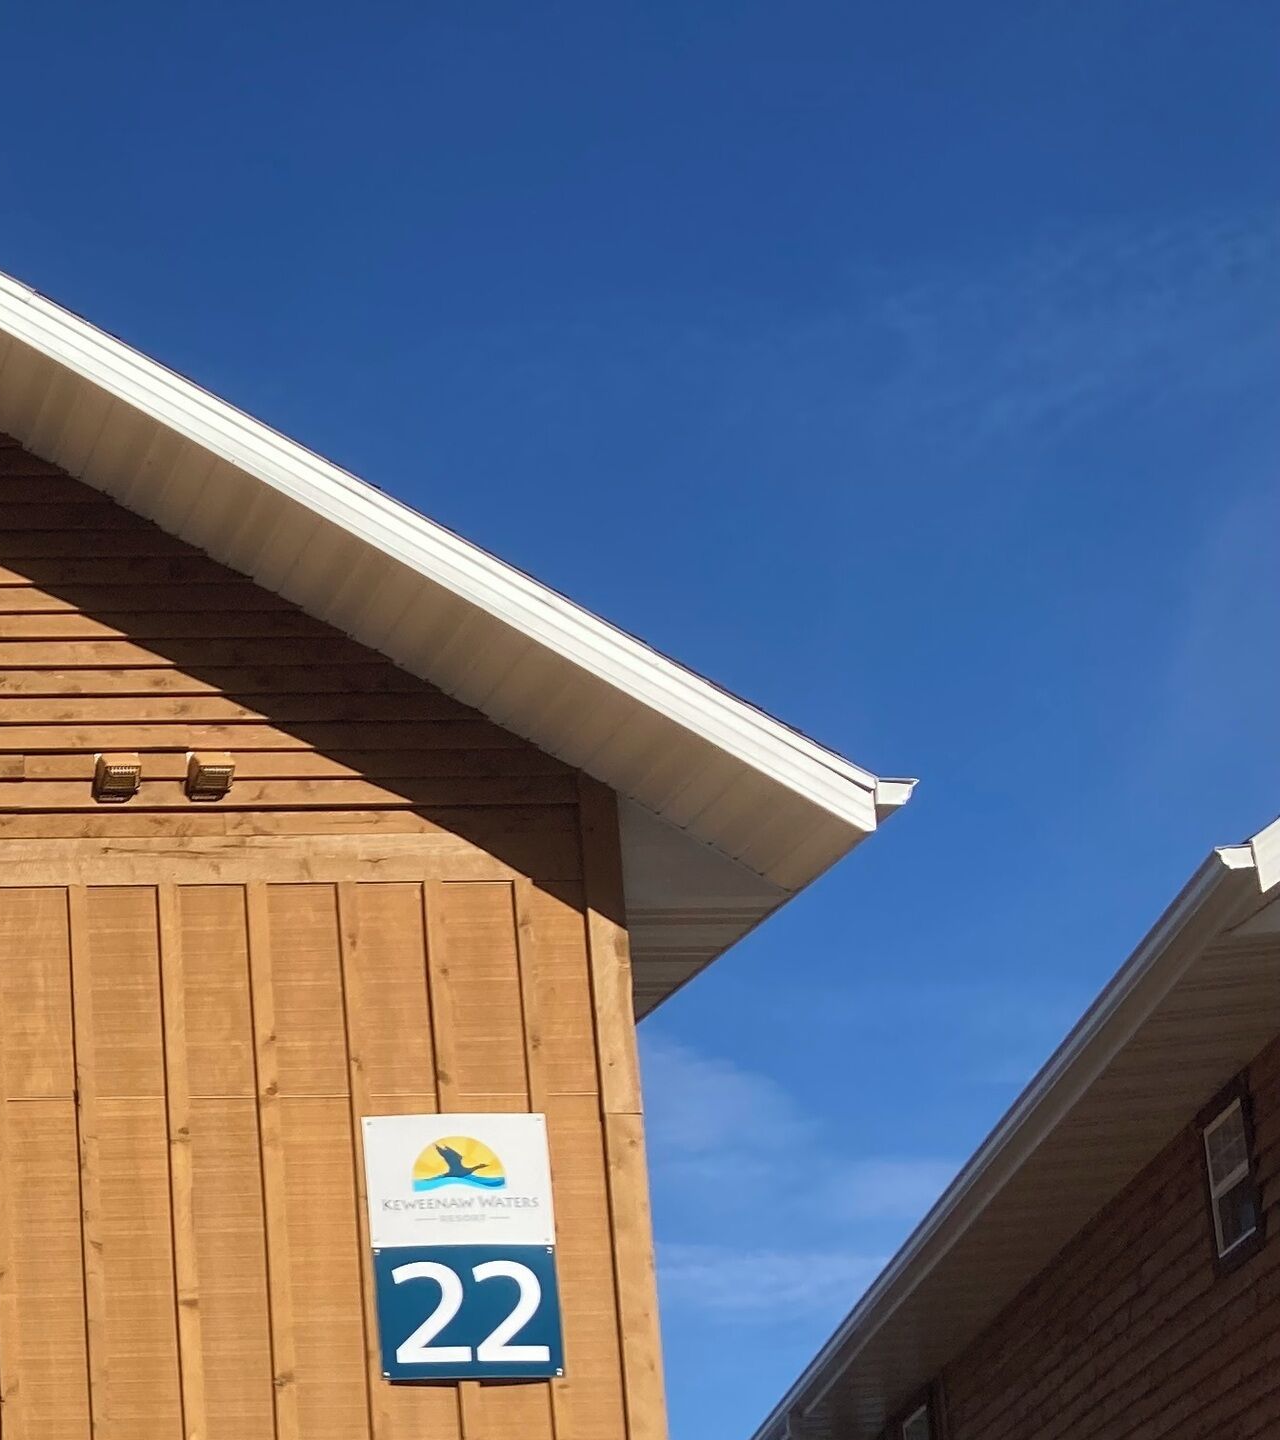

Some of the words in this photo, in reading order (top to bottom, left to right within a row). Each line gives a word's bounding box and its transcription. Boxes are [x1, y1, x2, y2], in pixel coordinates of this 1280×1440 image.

[382, 1198, 473, 1211] KEWEENAW
[477, 1196, 540, 1209] WATERS
[440, 1214, 486, 1223] RESORT
[391, 1260, 550, 1363] 22
